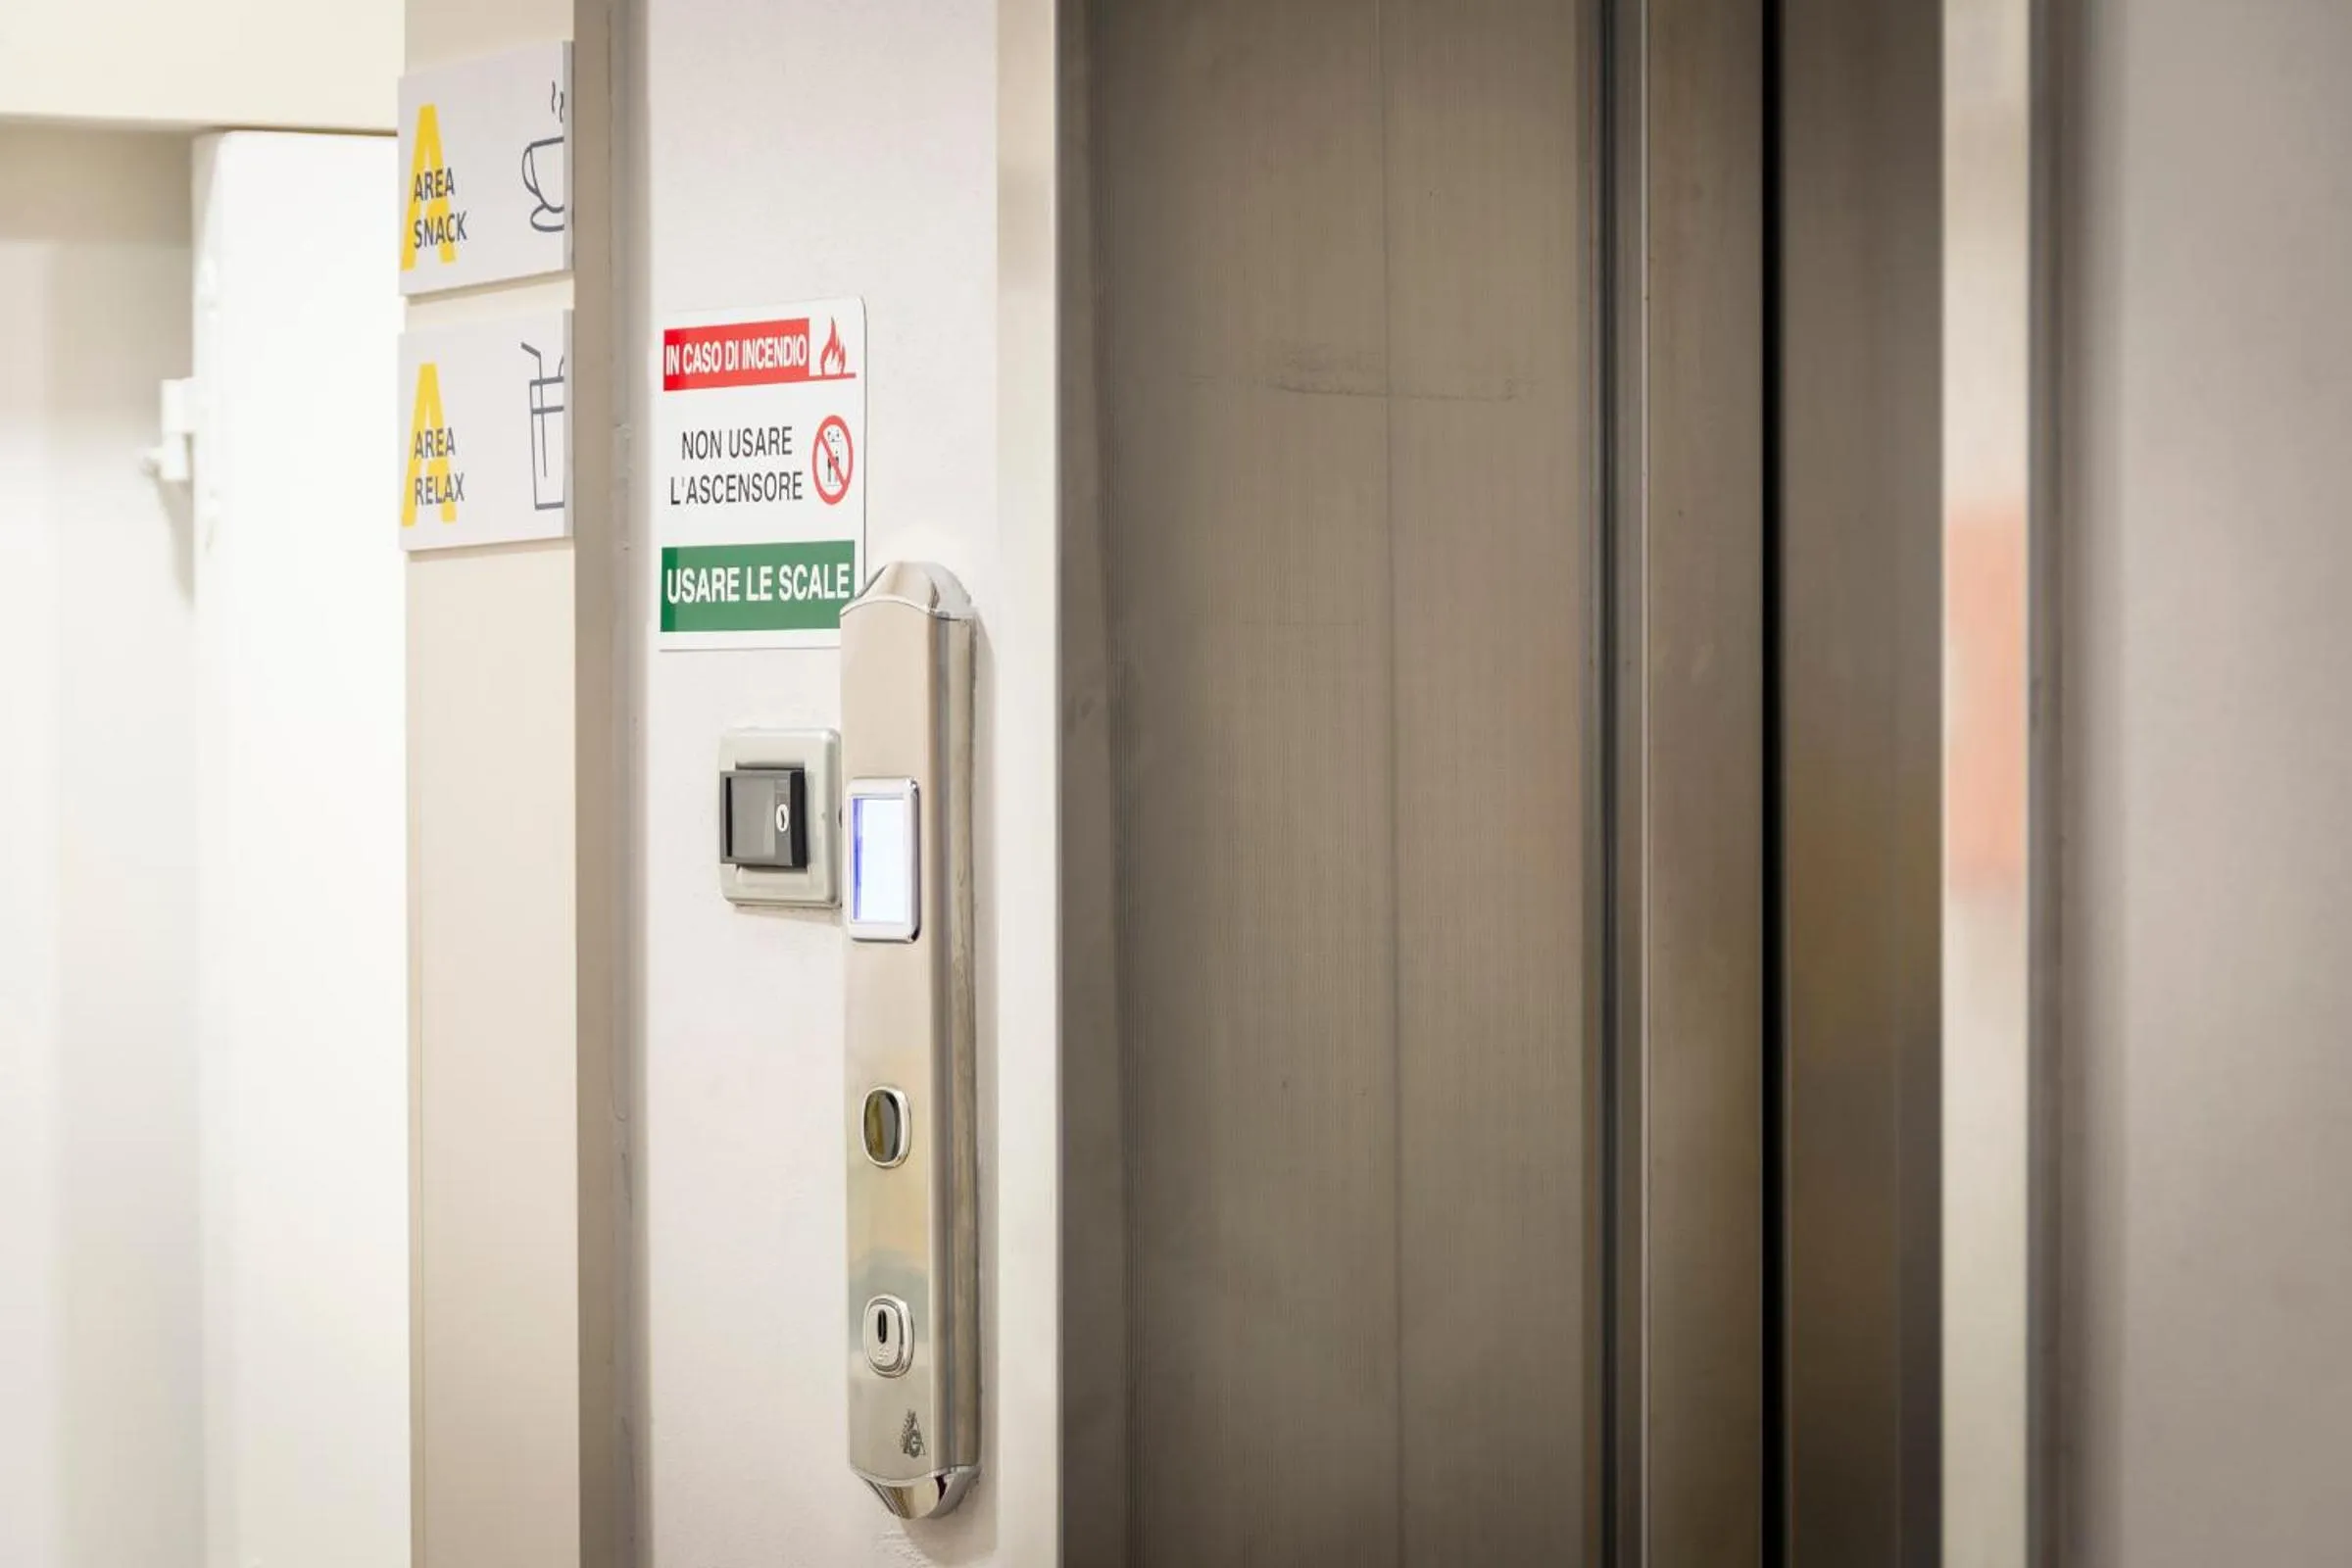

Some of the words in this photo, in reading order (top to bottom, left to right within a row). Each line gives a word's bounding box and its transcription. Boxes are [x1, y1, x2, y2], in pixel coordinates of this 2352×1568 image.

[401, 104, 457, 271] A
[413, 168, 455, 203] AREA
[414, 212, 467, 249] SNACK
[665, 345, 679, 376] IN
[683, 341, 722, 374] CASO
[724, 339, 740, 370] DI
[742, 334, 808, 369] INCENDIO
[401, 363, 457, 527] A
[414, 427, 456, 460] AREA
[681, 429, 723, 461] NON
[729, 425, 793, 458] USARE
[414, 472, 466, 507] RELAX
[670, 471, 804, 505] L'ASCENSORE
[667, 566, 741, 604] USARE
[746, 565, 773, 601] LE
[778, 563, 851, 601] SCALE
